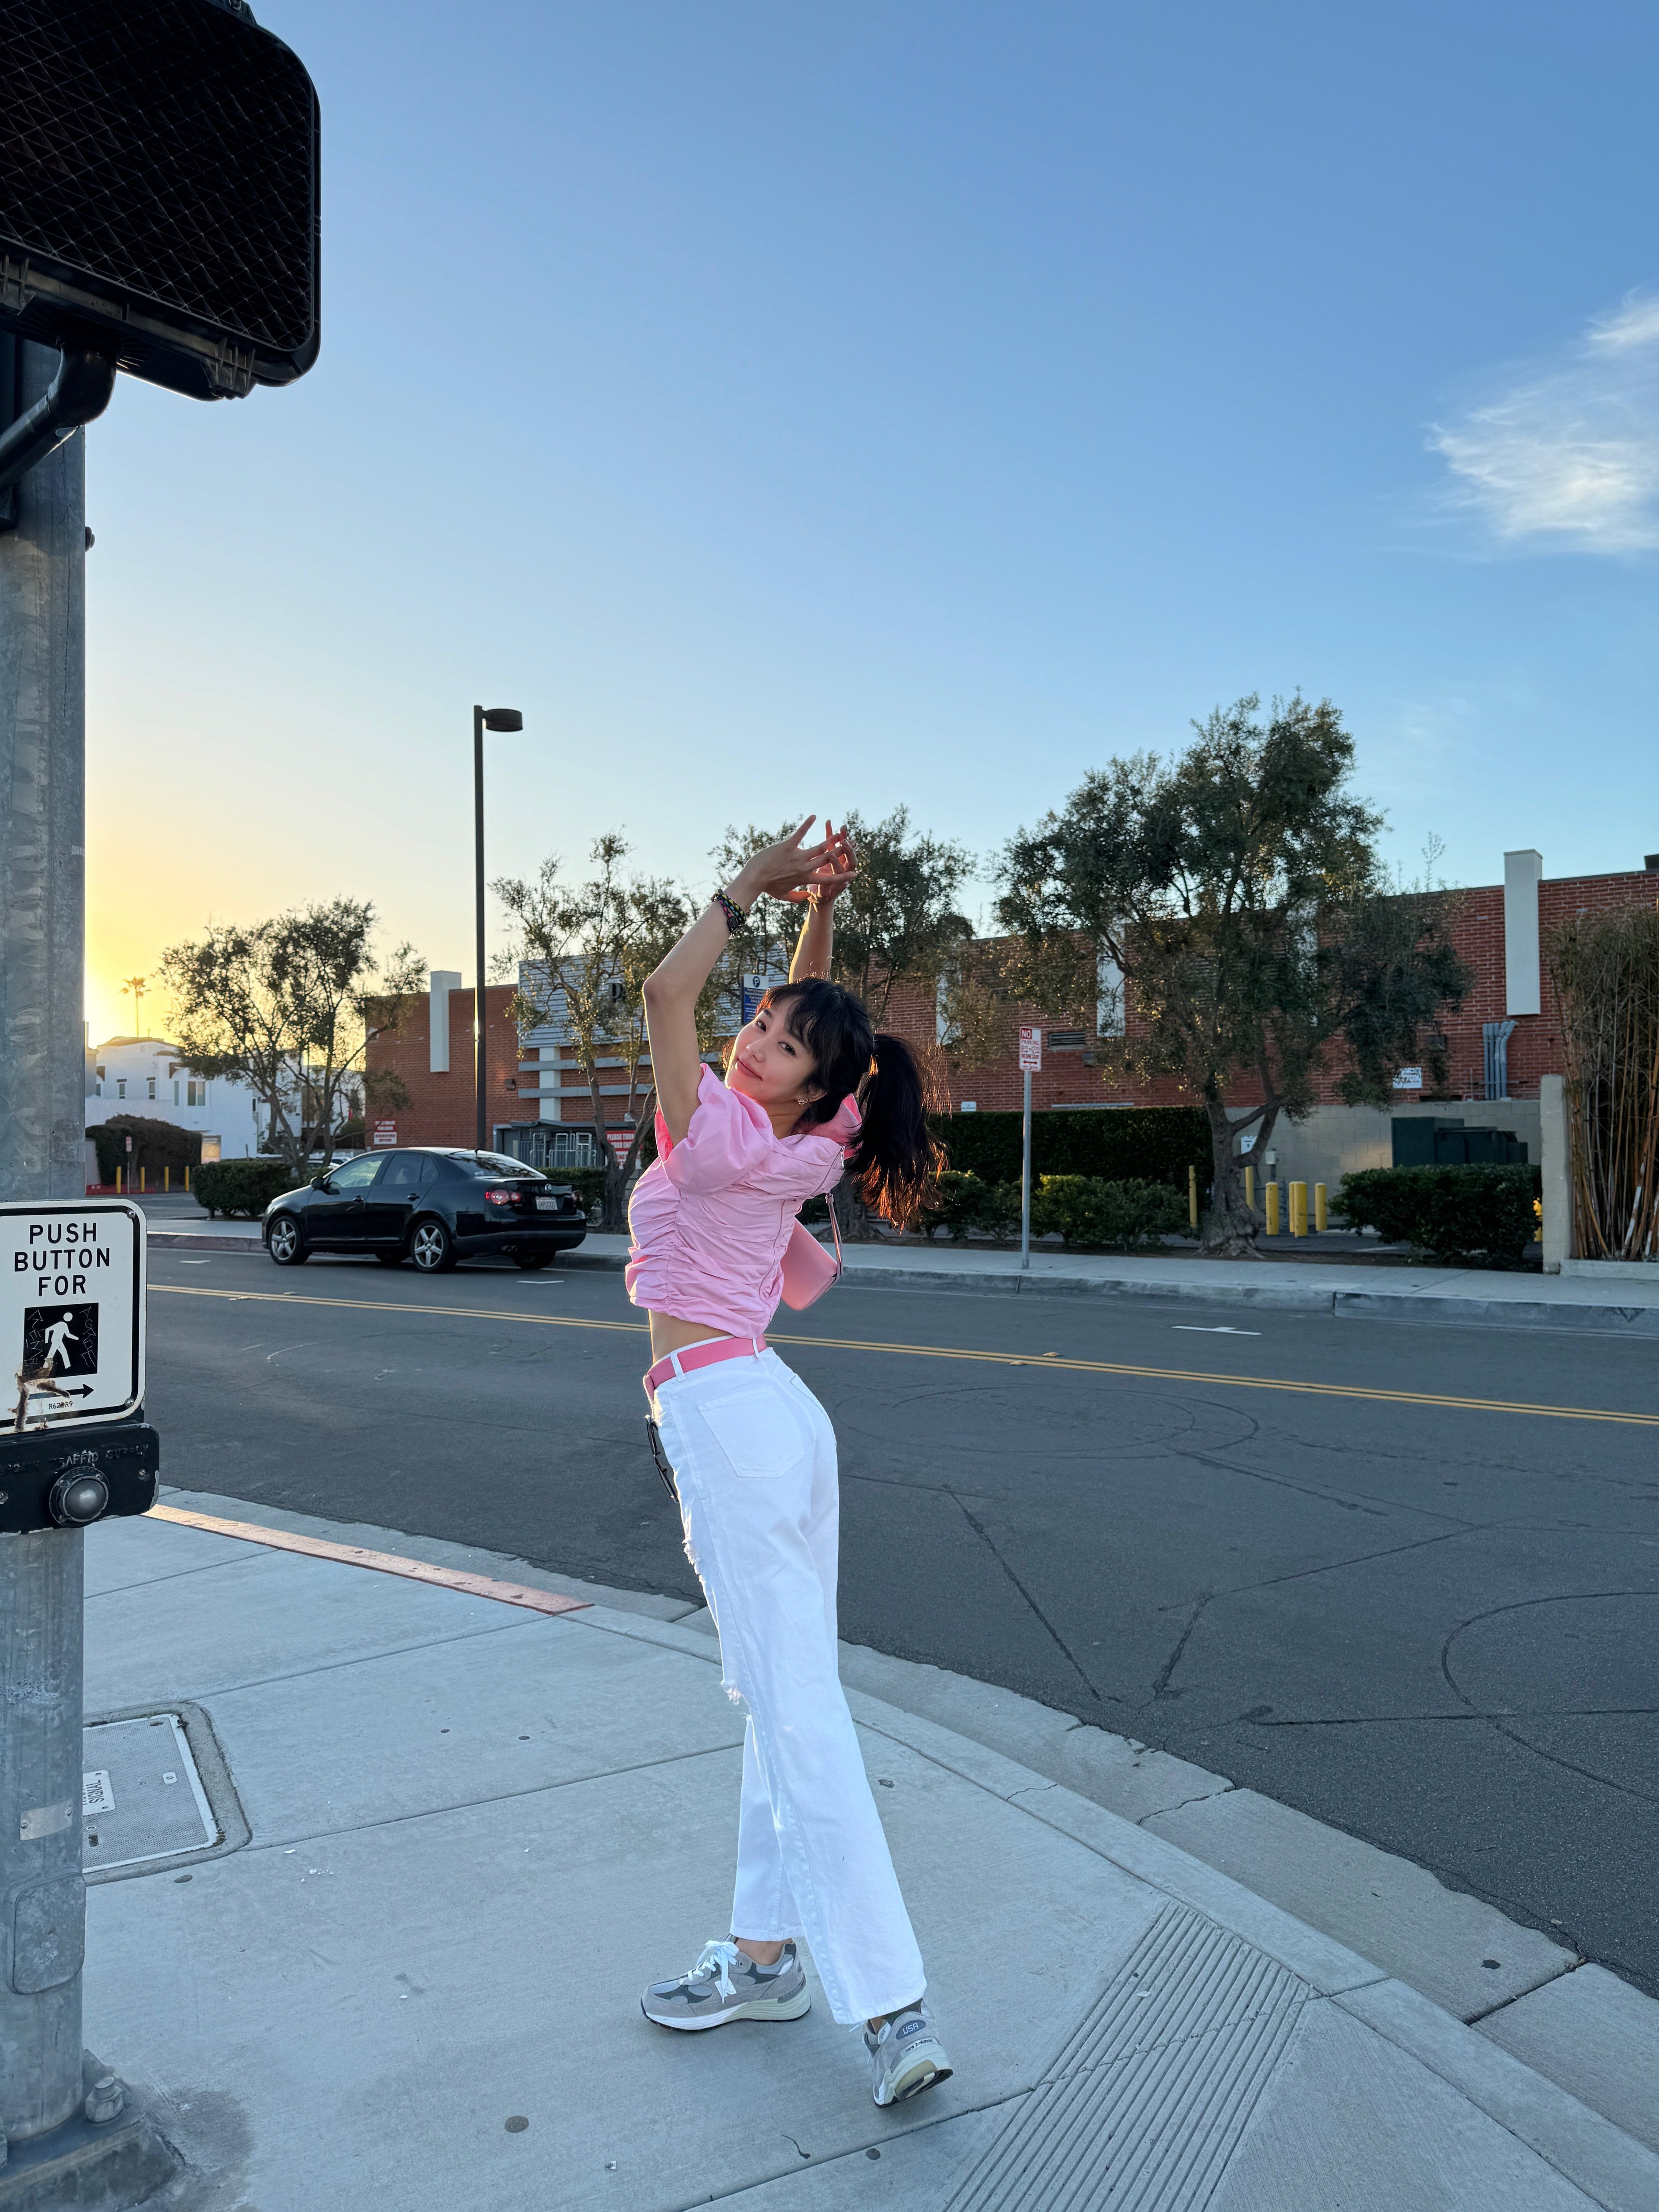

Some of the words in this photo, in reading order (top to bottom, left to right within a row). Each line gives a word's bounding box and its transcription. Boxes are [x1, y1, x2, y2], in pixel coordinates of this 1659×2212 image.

[1021, 1030, 1031, 1039] NO
[30, 1223, 96, 1245] PUSH
[14, 1248, 110, 1272] BUTTON
[38, 1274, 86, 1297] FOR
[86, 1780, 105, 1803] SIGNAL
[903, 2022, 919, 2034] USA
